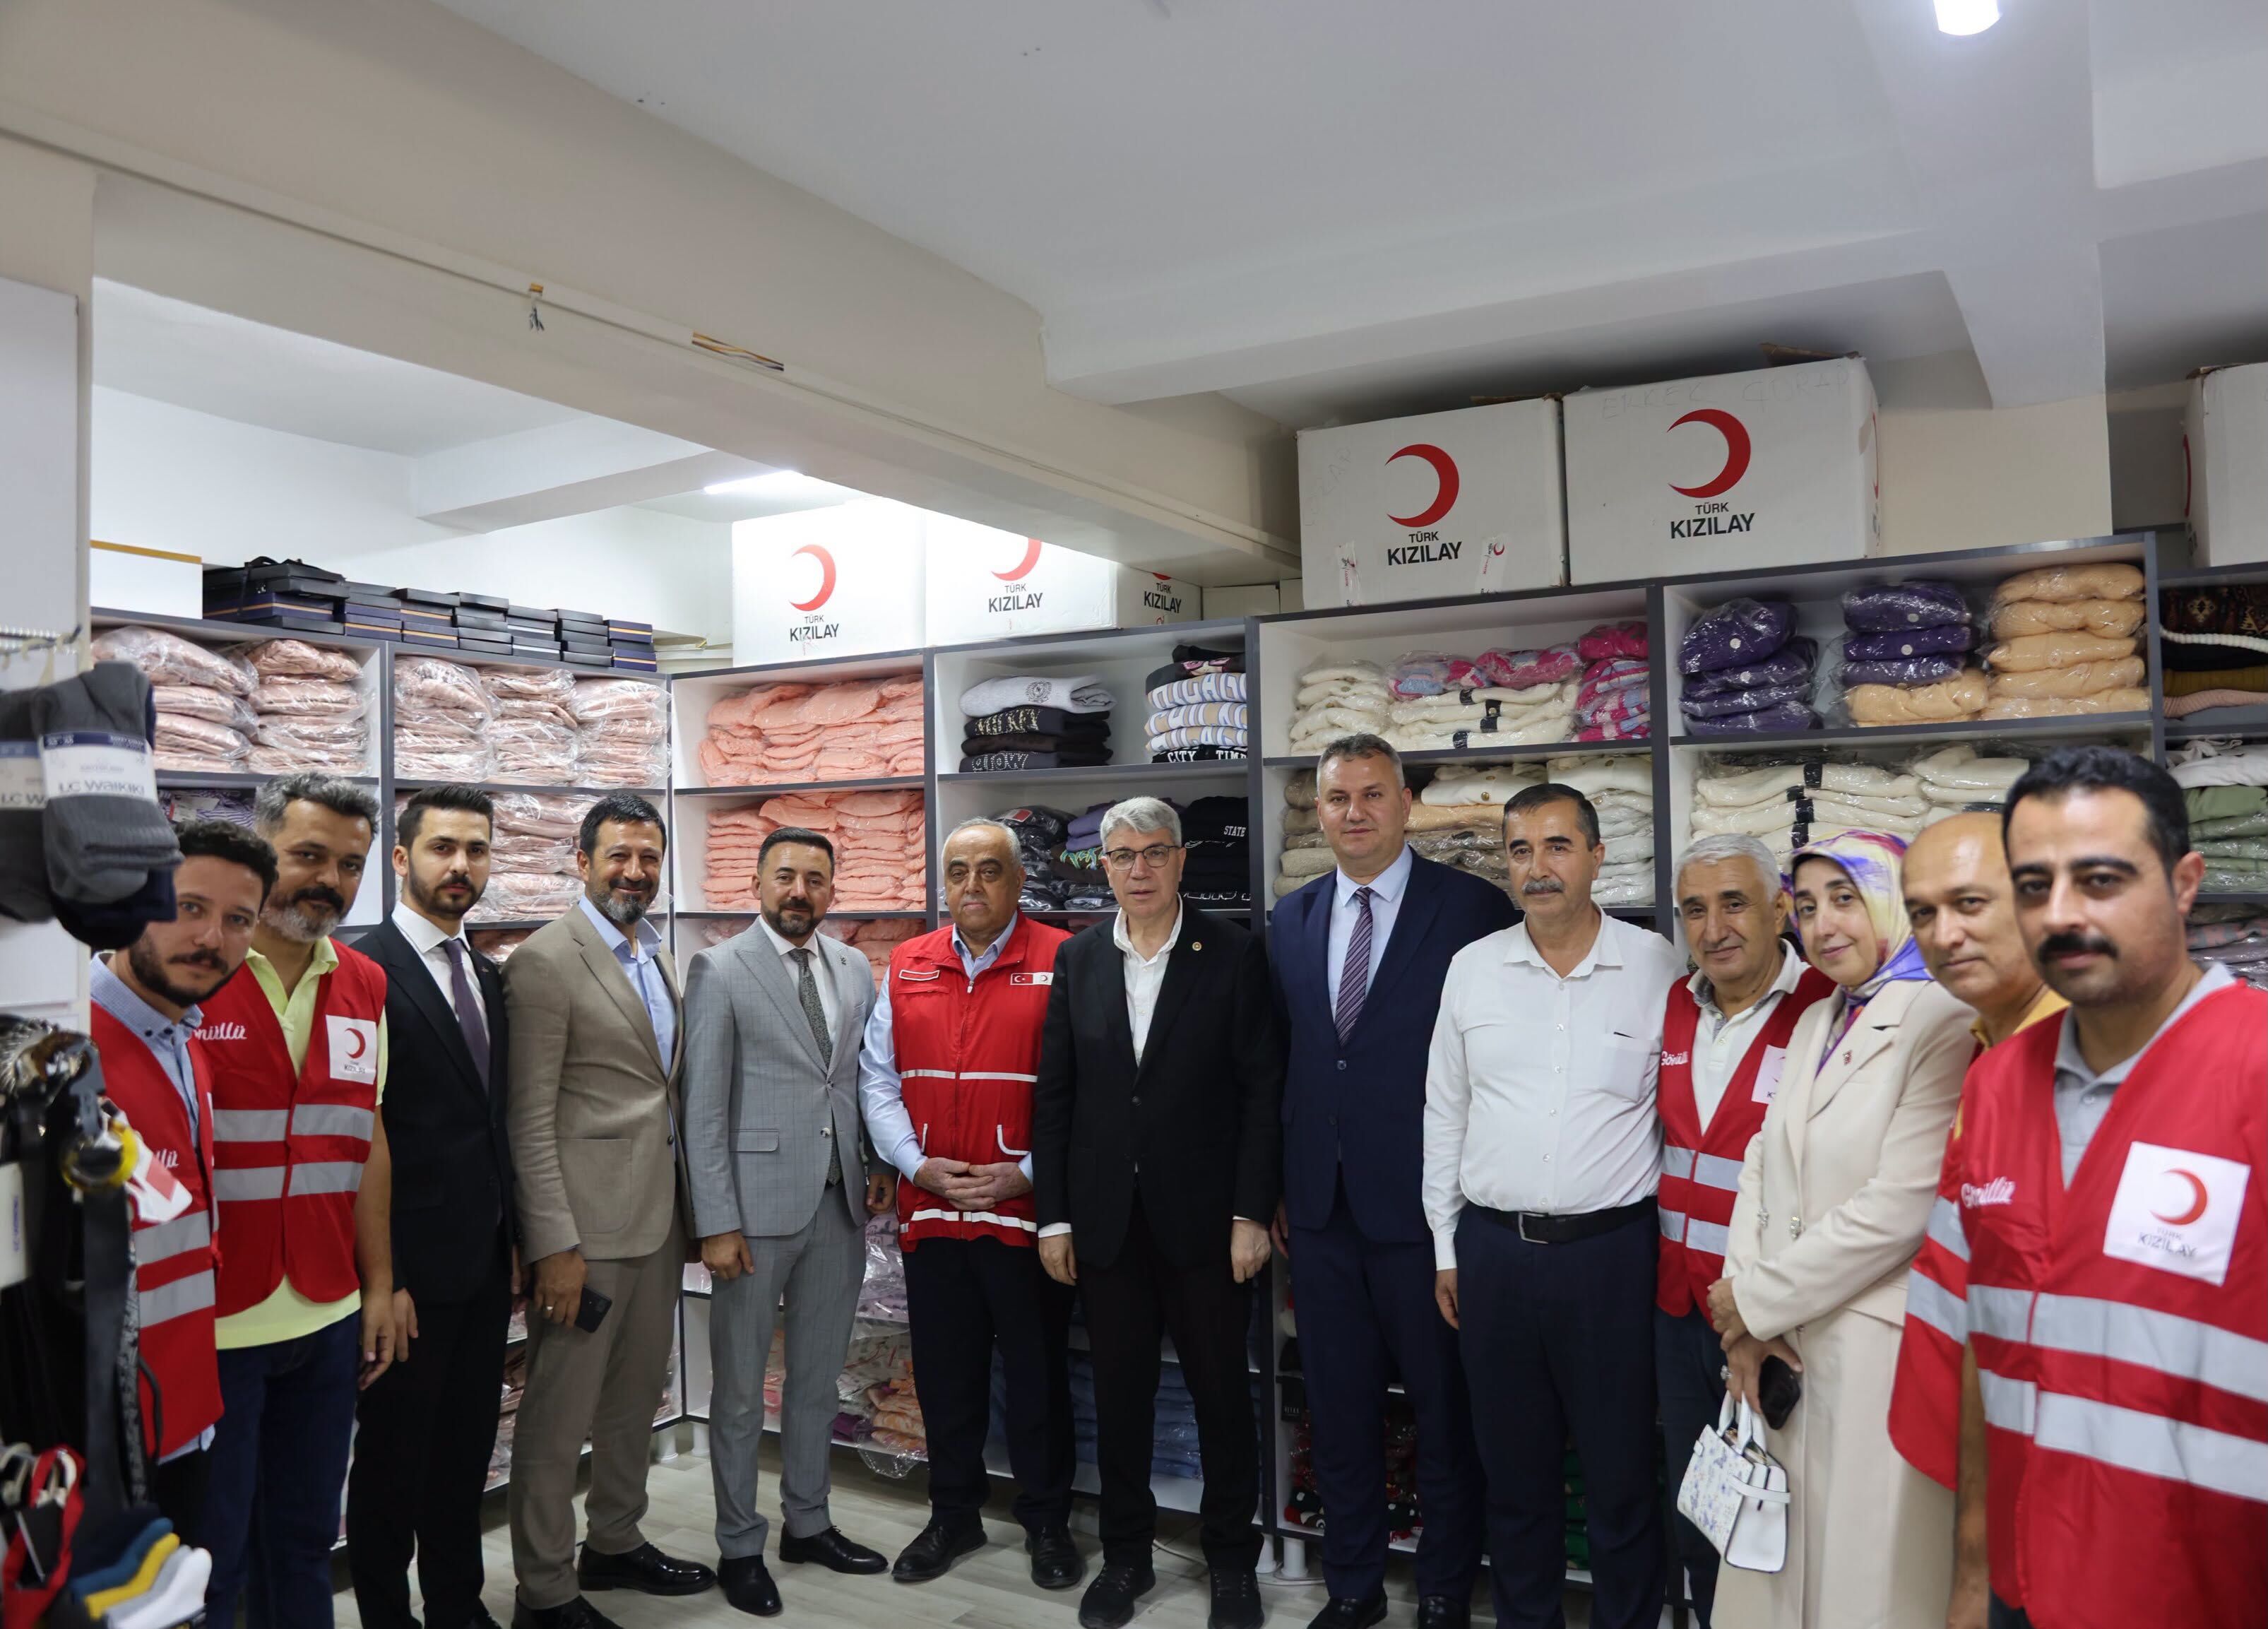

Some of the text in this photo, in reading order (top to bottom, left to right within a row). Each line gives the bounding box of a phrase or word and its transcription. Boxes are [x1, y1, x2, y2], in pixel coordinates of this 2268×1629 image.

[1695, 502, 1729, 514] TÜRK
[1670, 513, 1755, 538] KIZILAY
[1408, 531, 1439, 543] TÜRK
[1388, 542, 1462, 565] KIZILAY
[1004, 583, 1027, 593] TÜRK
[1156, 582, 1171, 594] TÜRK
[989, 593, 1043, 612] KIZILAY
[1144, 591, 1182, 613] KIZILAY
[805, 614, 824, 624] TÜRK
[790, 623, 839, 641] KIZILAY
[1168, 750, 1197, 762] CITY
[59, 781, 81, 792] LC
[1223, 825, 1246, 837] STATE
